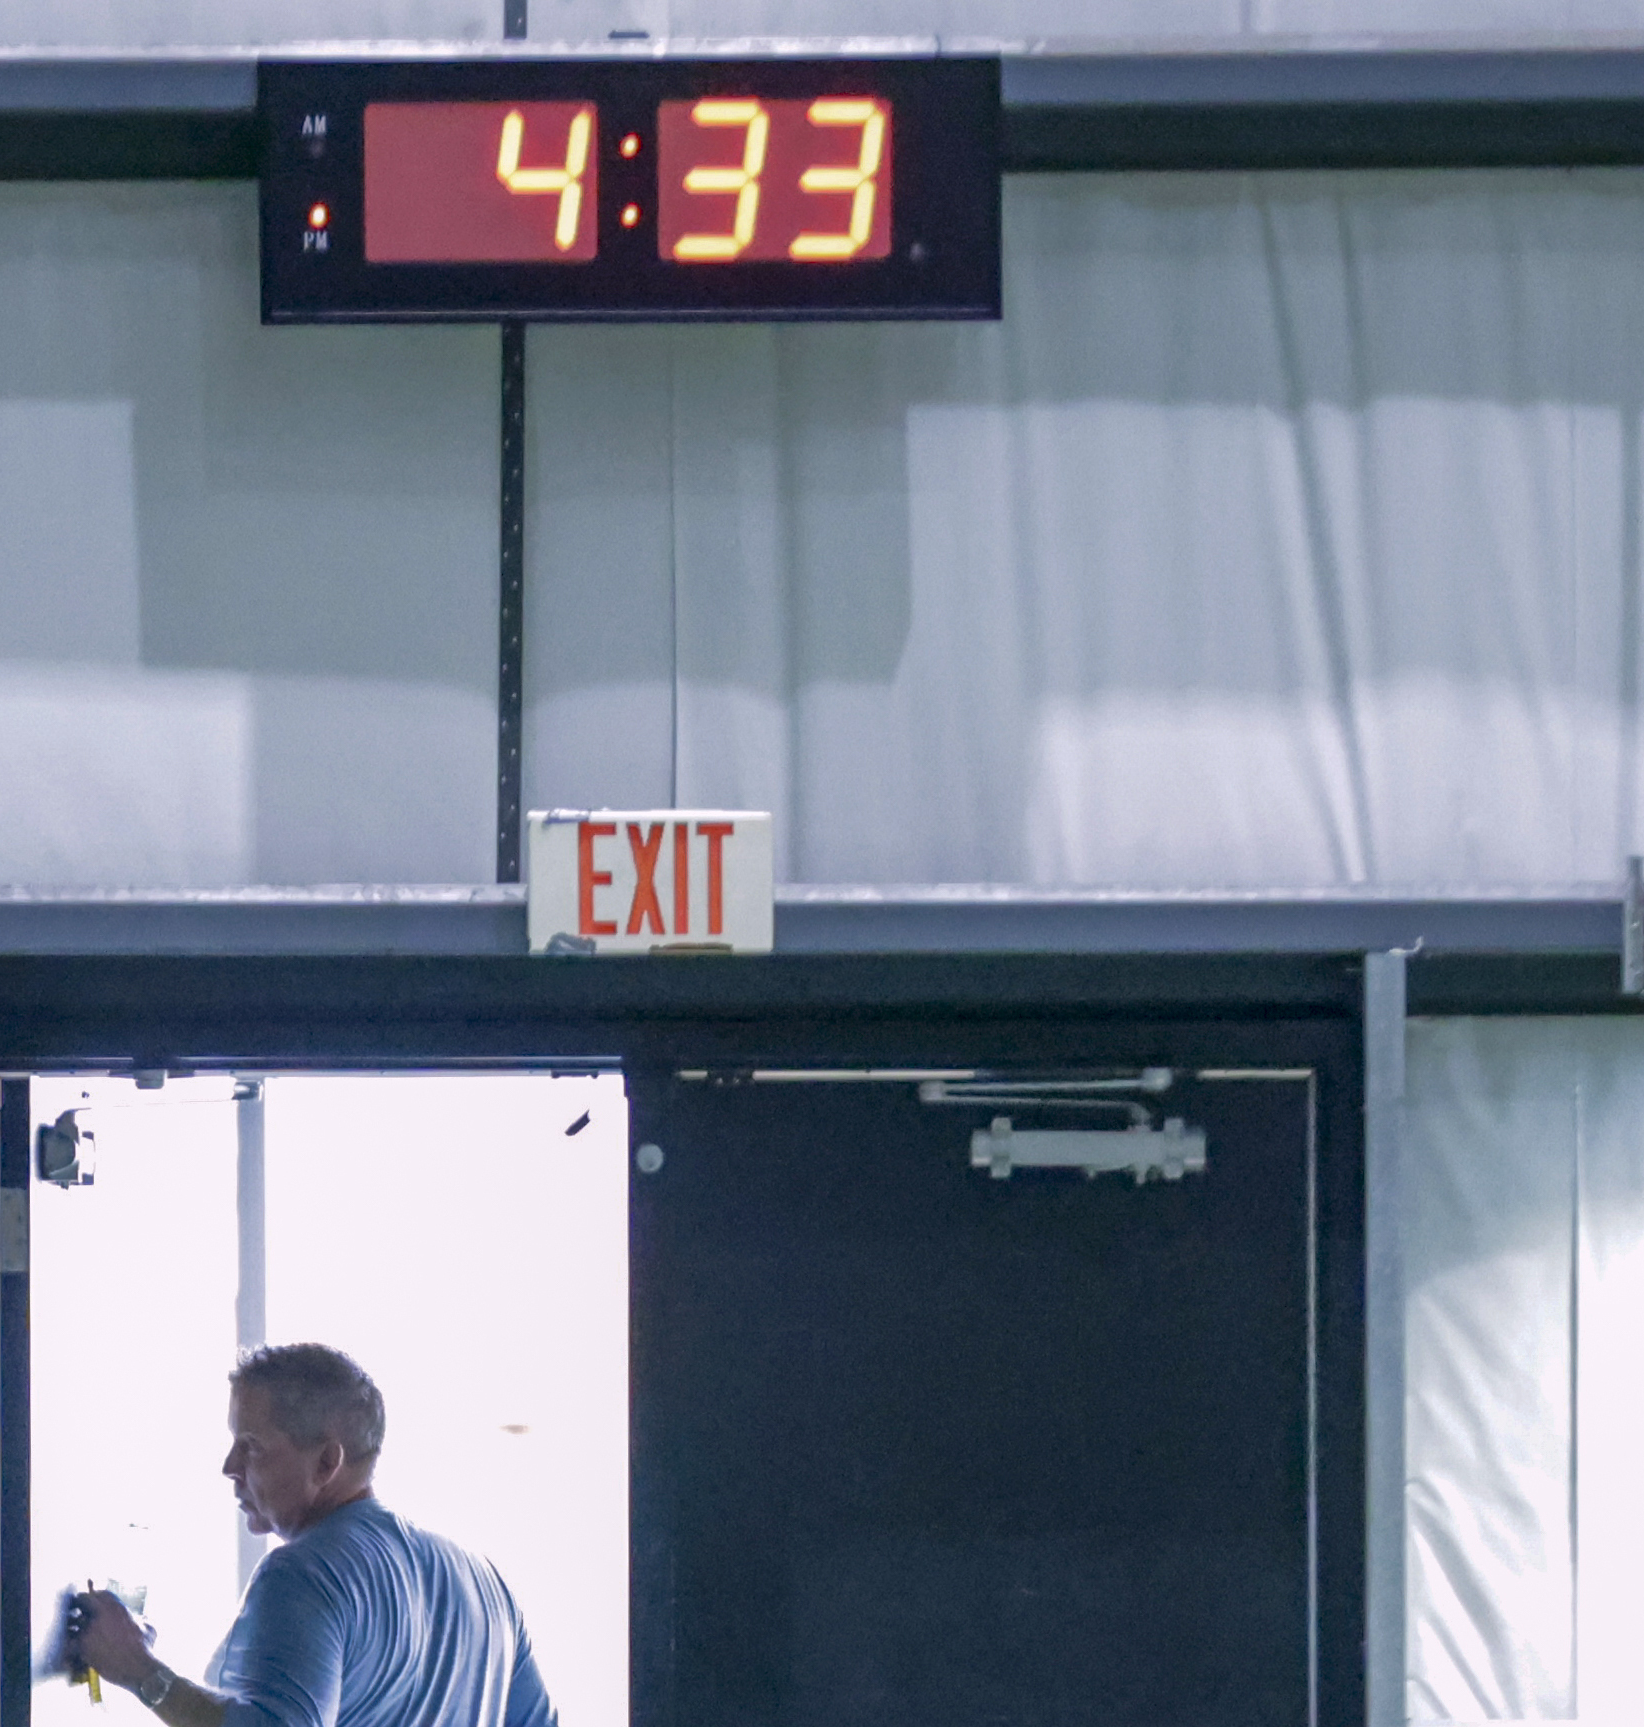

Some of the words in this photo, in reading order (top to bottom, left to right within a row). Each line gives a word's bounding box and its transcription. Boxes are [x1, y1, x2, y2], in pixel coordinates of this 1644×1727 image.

[301, 114, 327, 134] AM
[495, 95, 886, 262] 4:33
[303, 231, 328, 252] PM
[577, 820, 734, 935] EXIT
